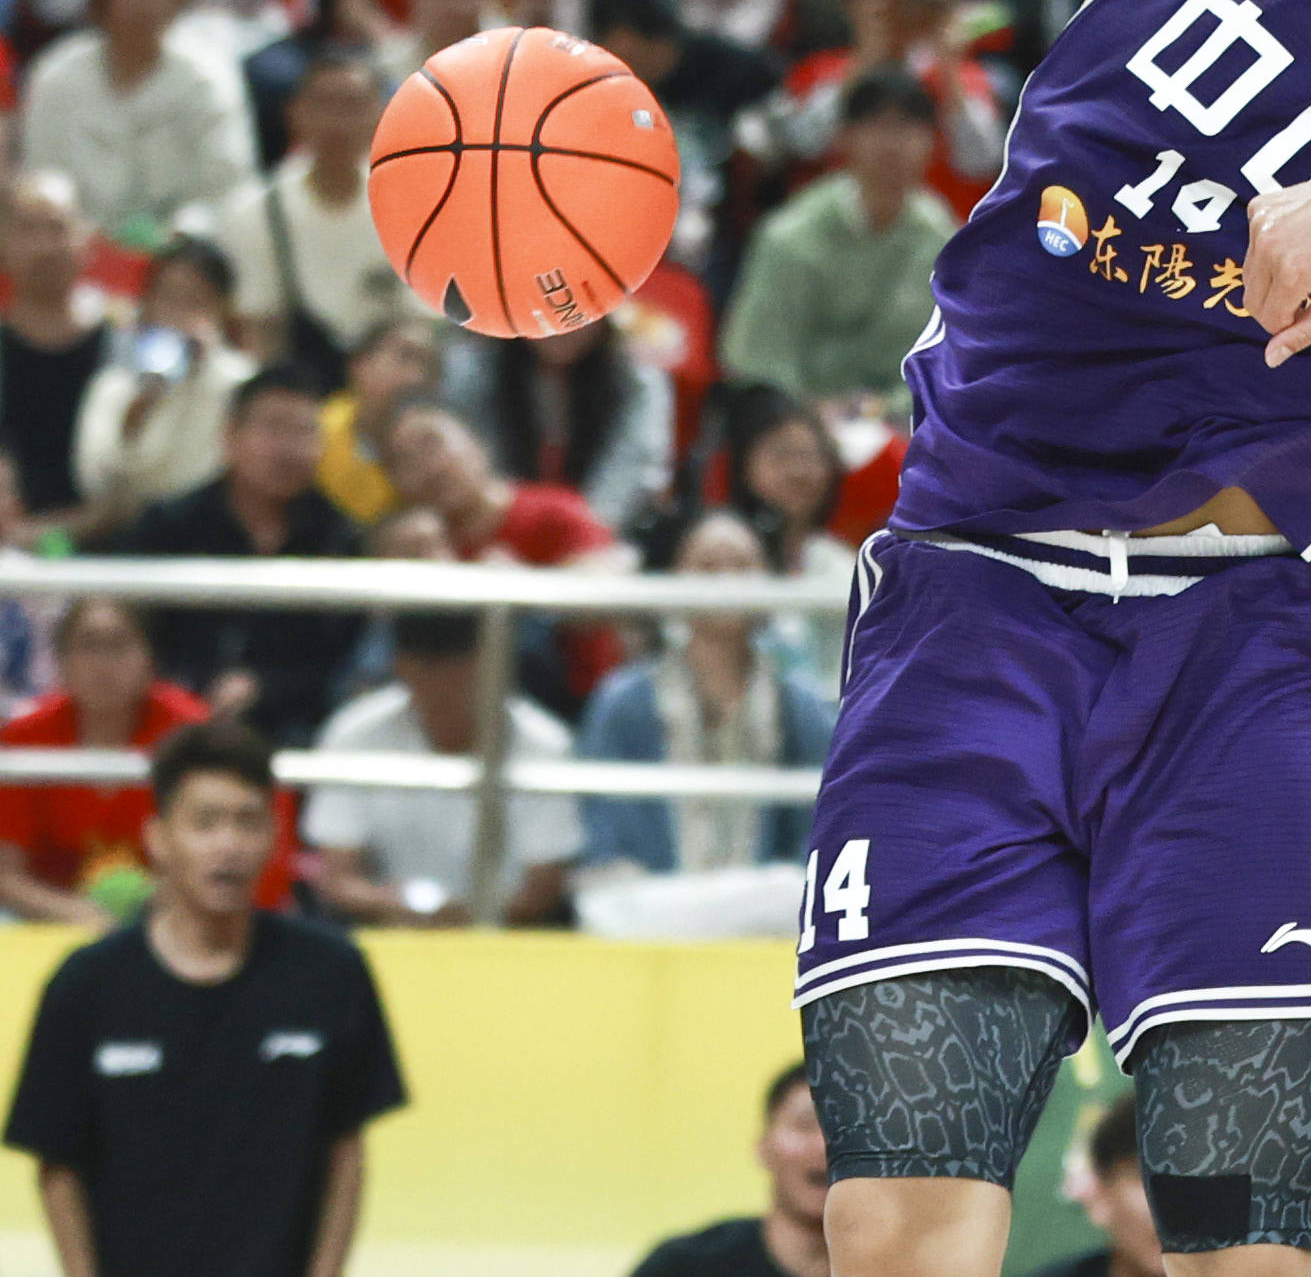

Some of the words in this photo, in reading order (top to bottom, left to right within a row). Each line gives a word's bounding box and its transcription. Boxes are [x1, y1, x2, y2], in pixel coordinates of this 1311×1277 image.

[1112, 149, 1238, 234] 14
[1043, 230, 1070, 253] HEC
[797, 838, 871, 955] 14
